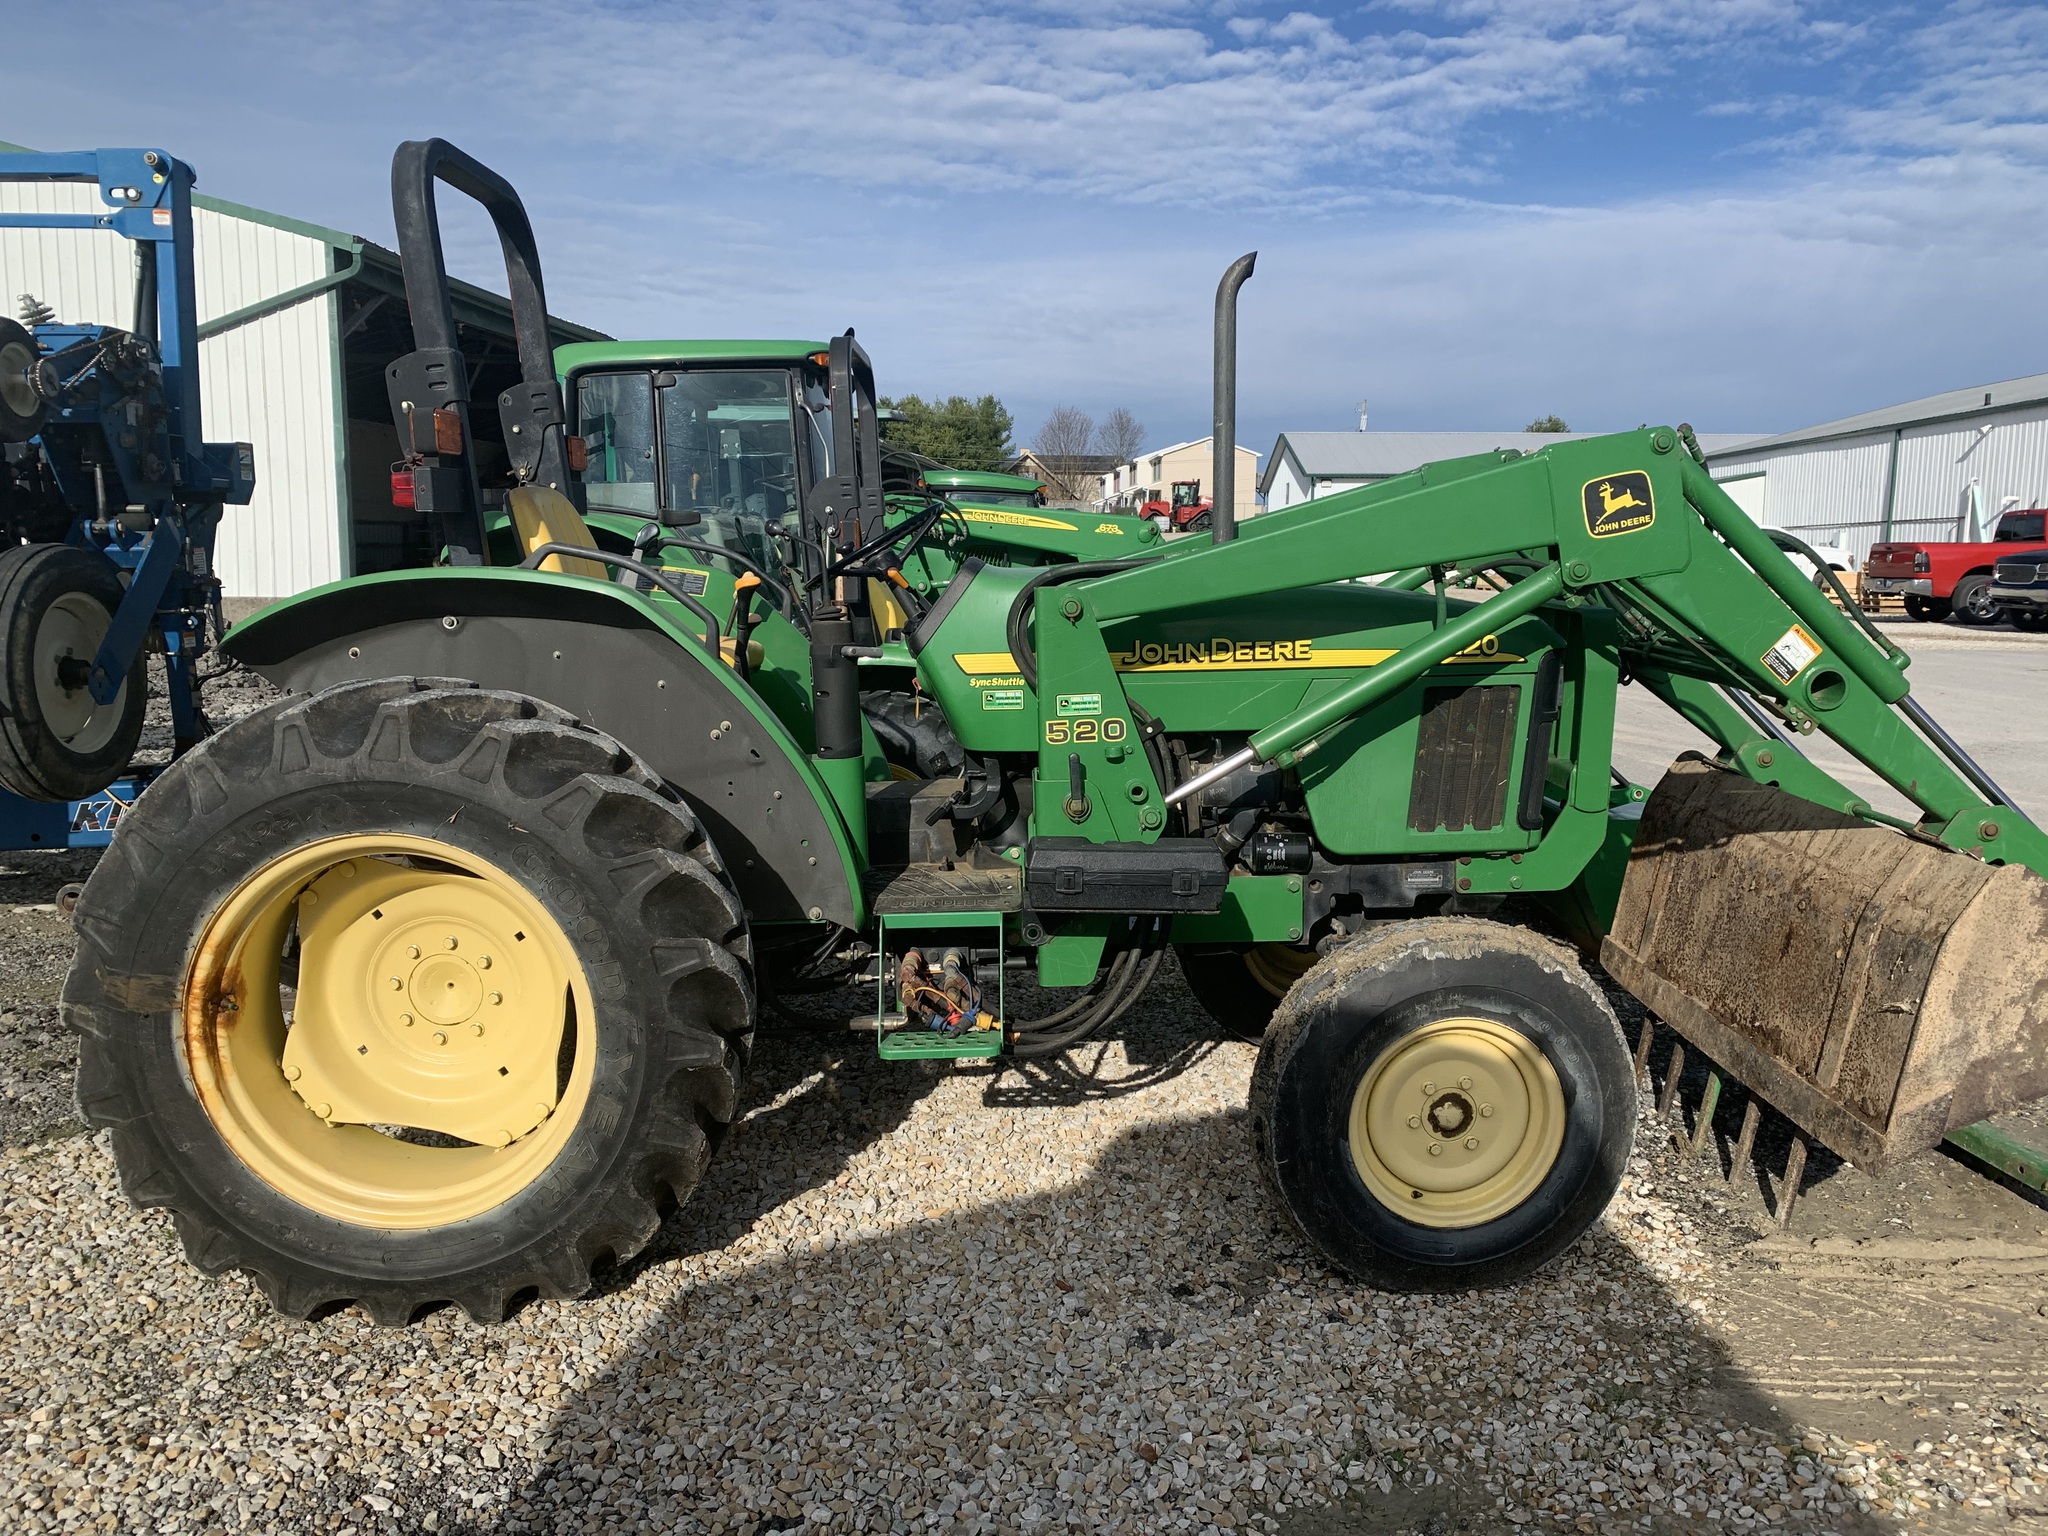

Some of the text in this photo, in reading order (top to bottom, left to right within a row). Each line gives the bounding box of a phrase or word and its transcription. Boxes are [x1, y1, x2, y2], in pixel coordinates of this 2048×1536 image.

[1099, 523, 1119, 533] 673
[1593, 515, 1652, 534] JOHN DEERE
[1122, 637, 1313, 664] JOHN DEERE
[1455, 633, 1499, 656] 20
[969, 677, 1025, 688] SyncShuttle
[1046, 717, 1127, 745] 520
[69, 800, 134, 833] KI
[891, 898, 998, 909] JOHN DEERE
